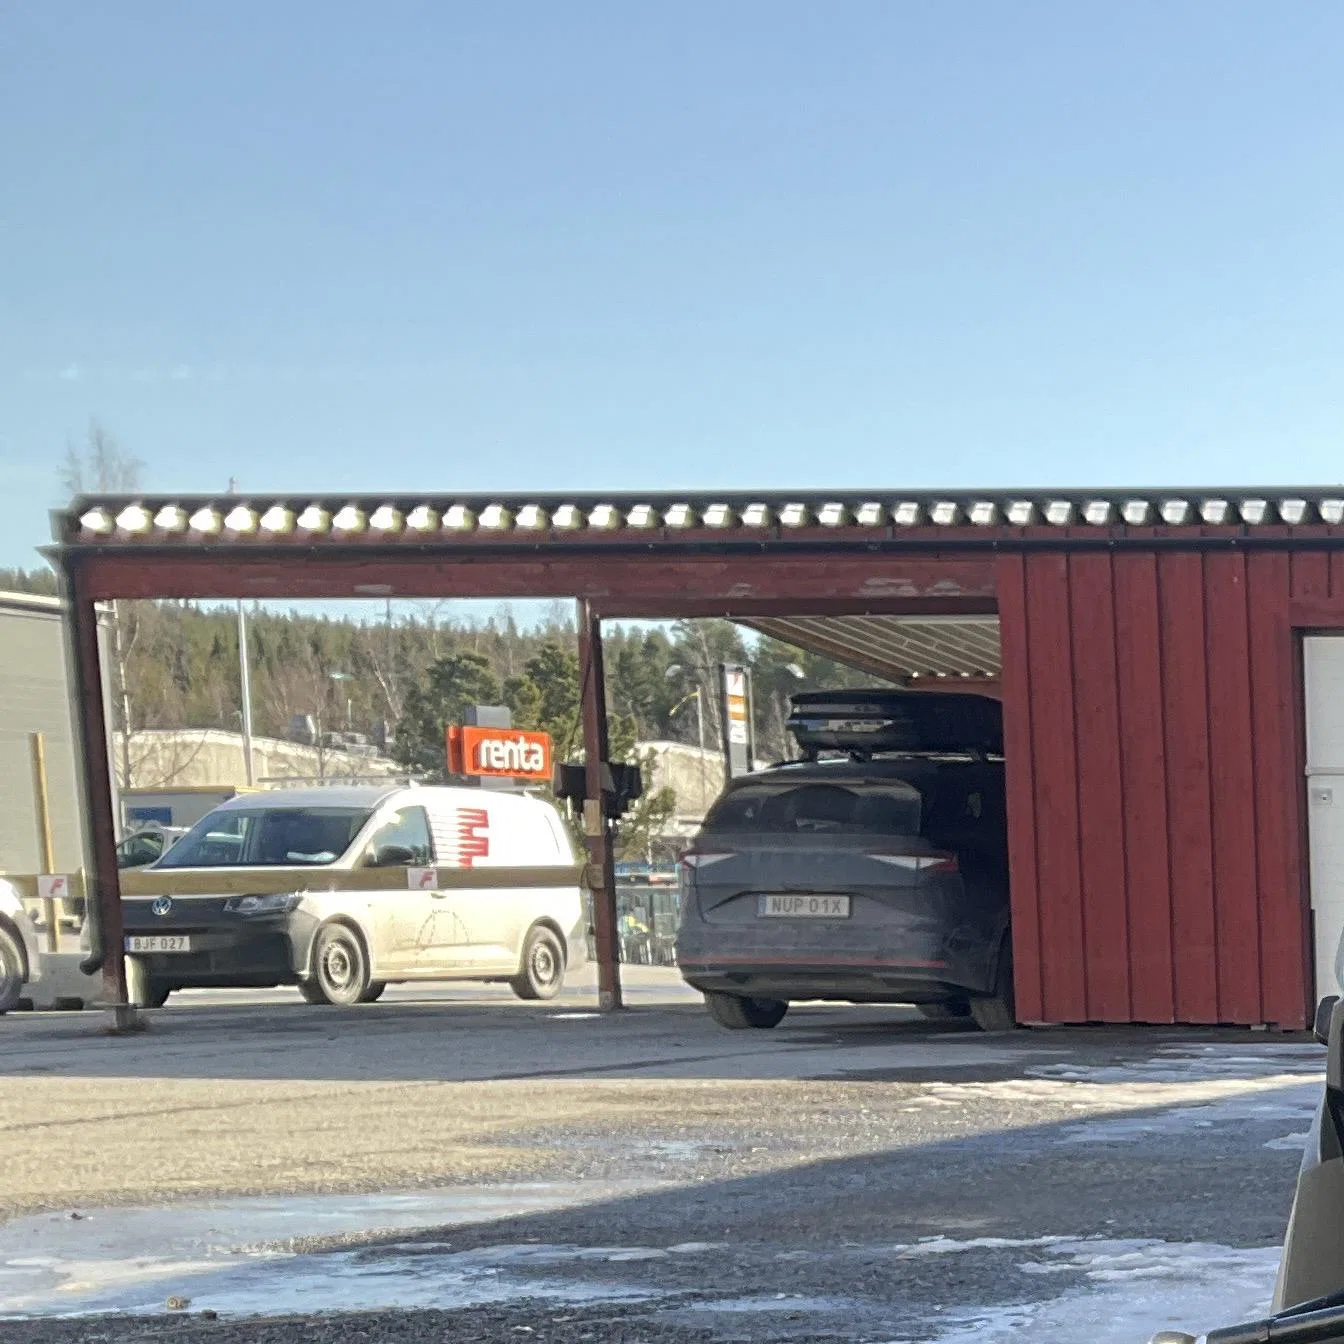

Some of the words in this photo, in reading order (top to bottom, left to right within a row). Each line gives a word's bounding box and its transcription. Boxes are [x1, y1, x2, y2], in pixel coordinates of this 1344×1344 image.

[480, 735, 544, 772] renta
[771, 897, 804, 913] NUP
[808, 898, 841, 914] 01X
[160, 937, 185, 950] 027
